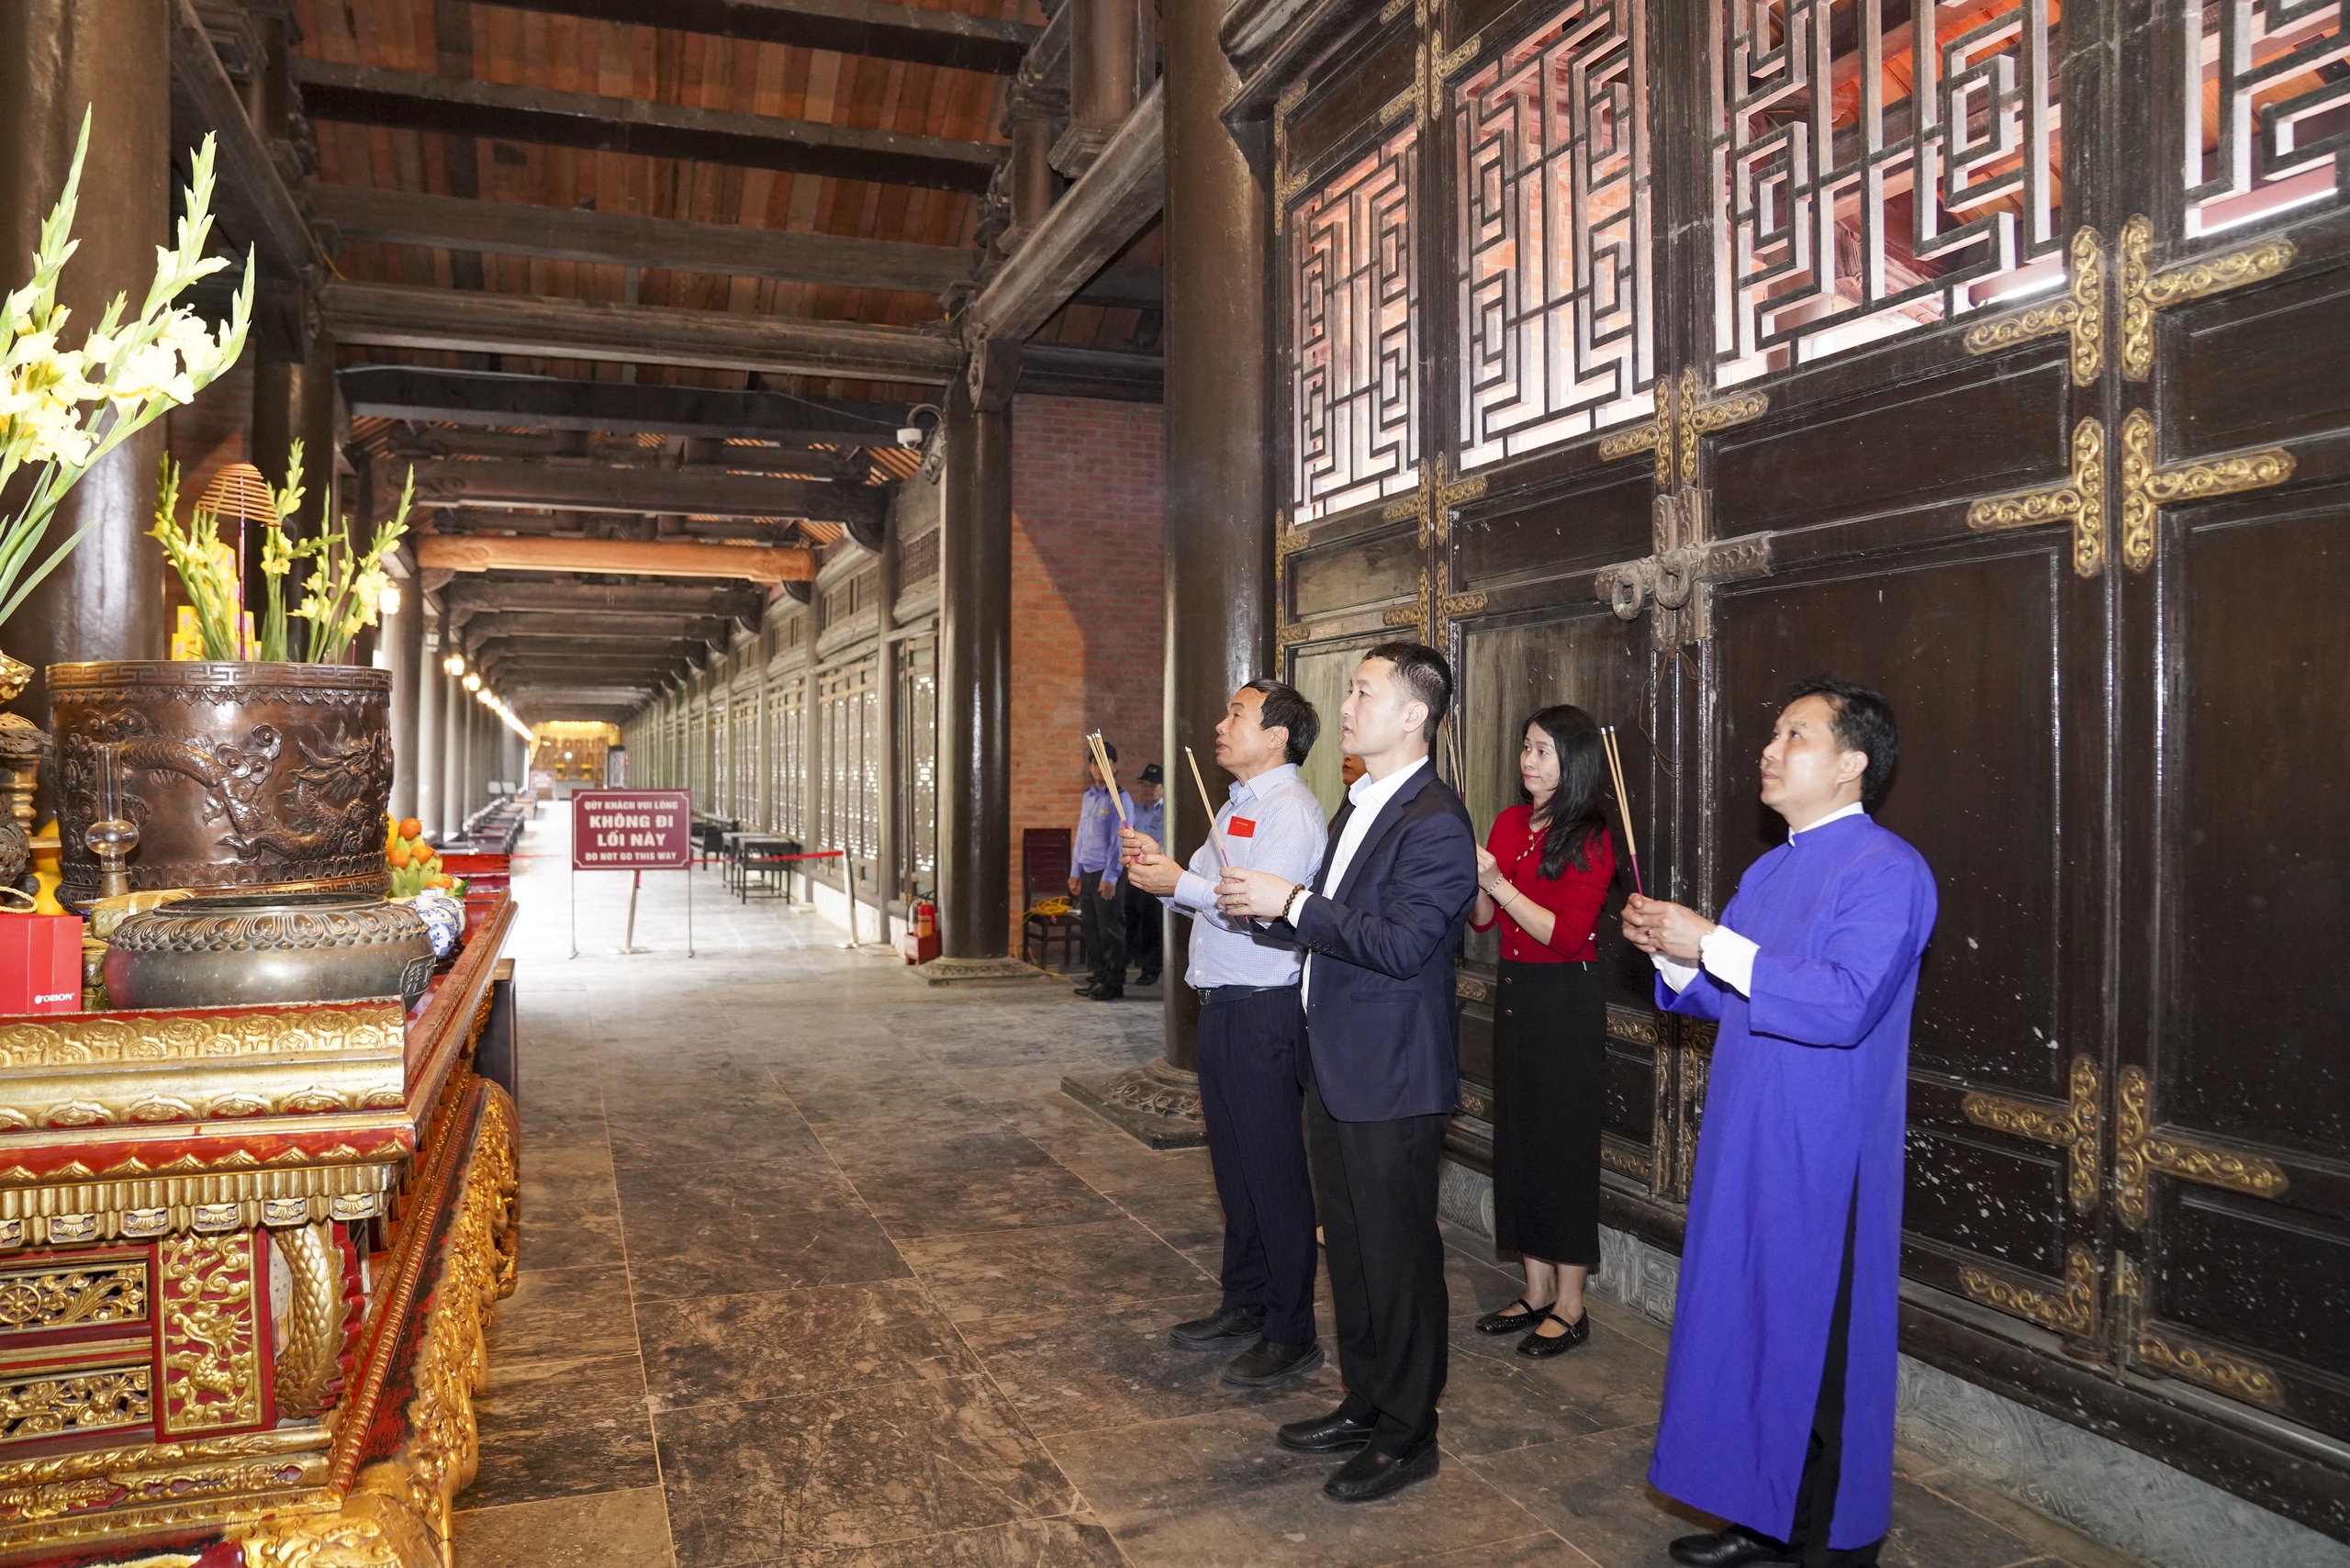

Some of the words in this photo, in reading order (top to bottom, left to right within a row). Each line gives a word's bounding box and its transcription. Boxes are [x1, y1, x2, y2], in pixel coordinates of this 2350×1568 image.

[604, 800, 635, 810] KHÁCH
[637, 801, 653, 810] VUI
[589, 812, 650, 828] KHÔNG
[655, 815, 674, 828] ĐI
[630, 831, 666, 846] NÀY
[586, 852, 599, 861] DO
[600, 852, 618, 861] NOT
[620, 852, 633, 861] GO
[634, 852, 655, 860] THIS
[656, 852, 677, 860] WAY
[43, 992, 73, 1002] ORION
